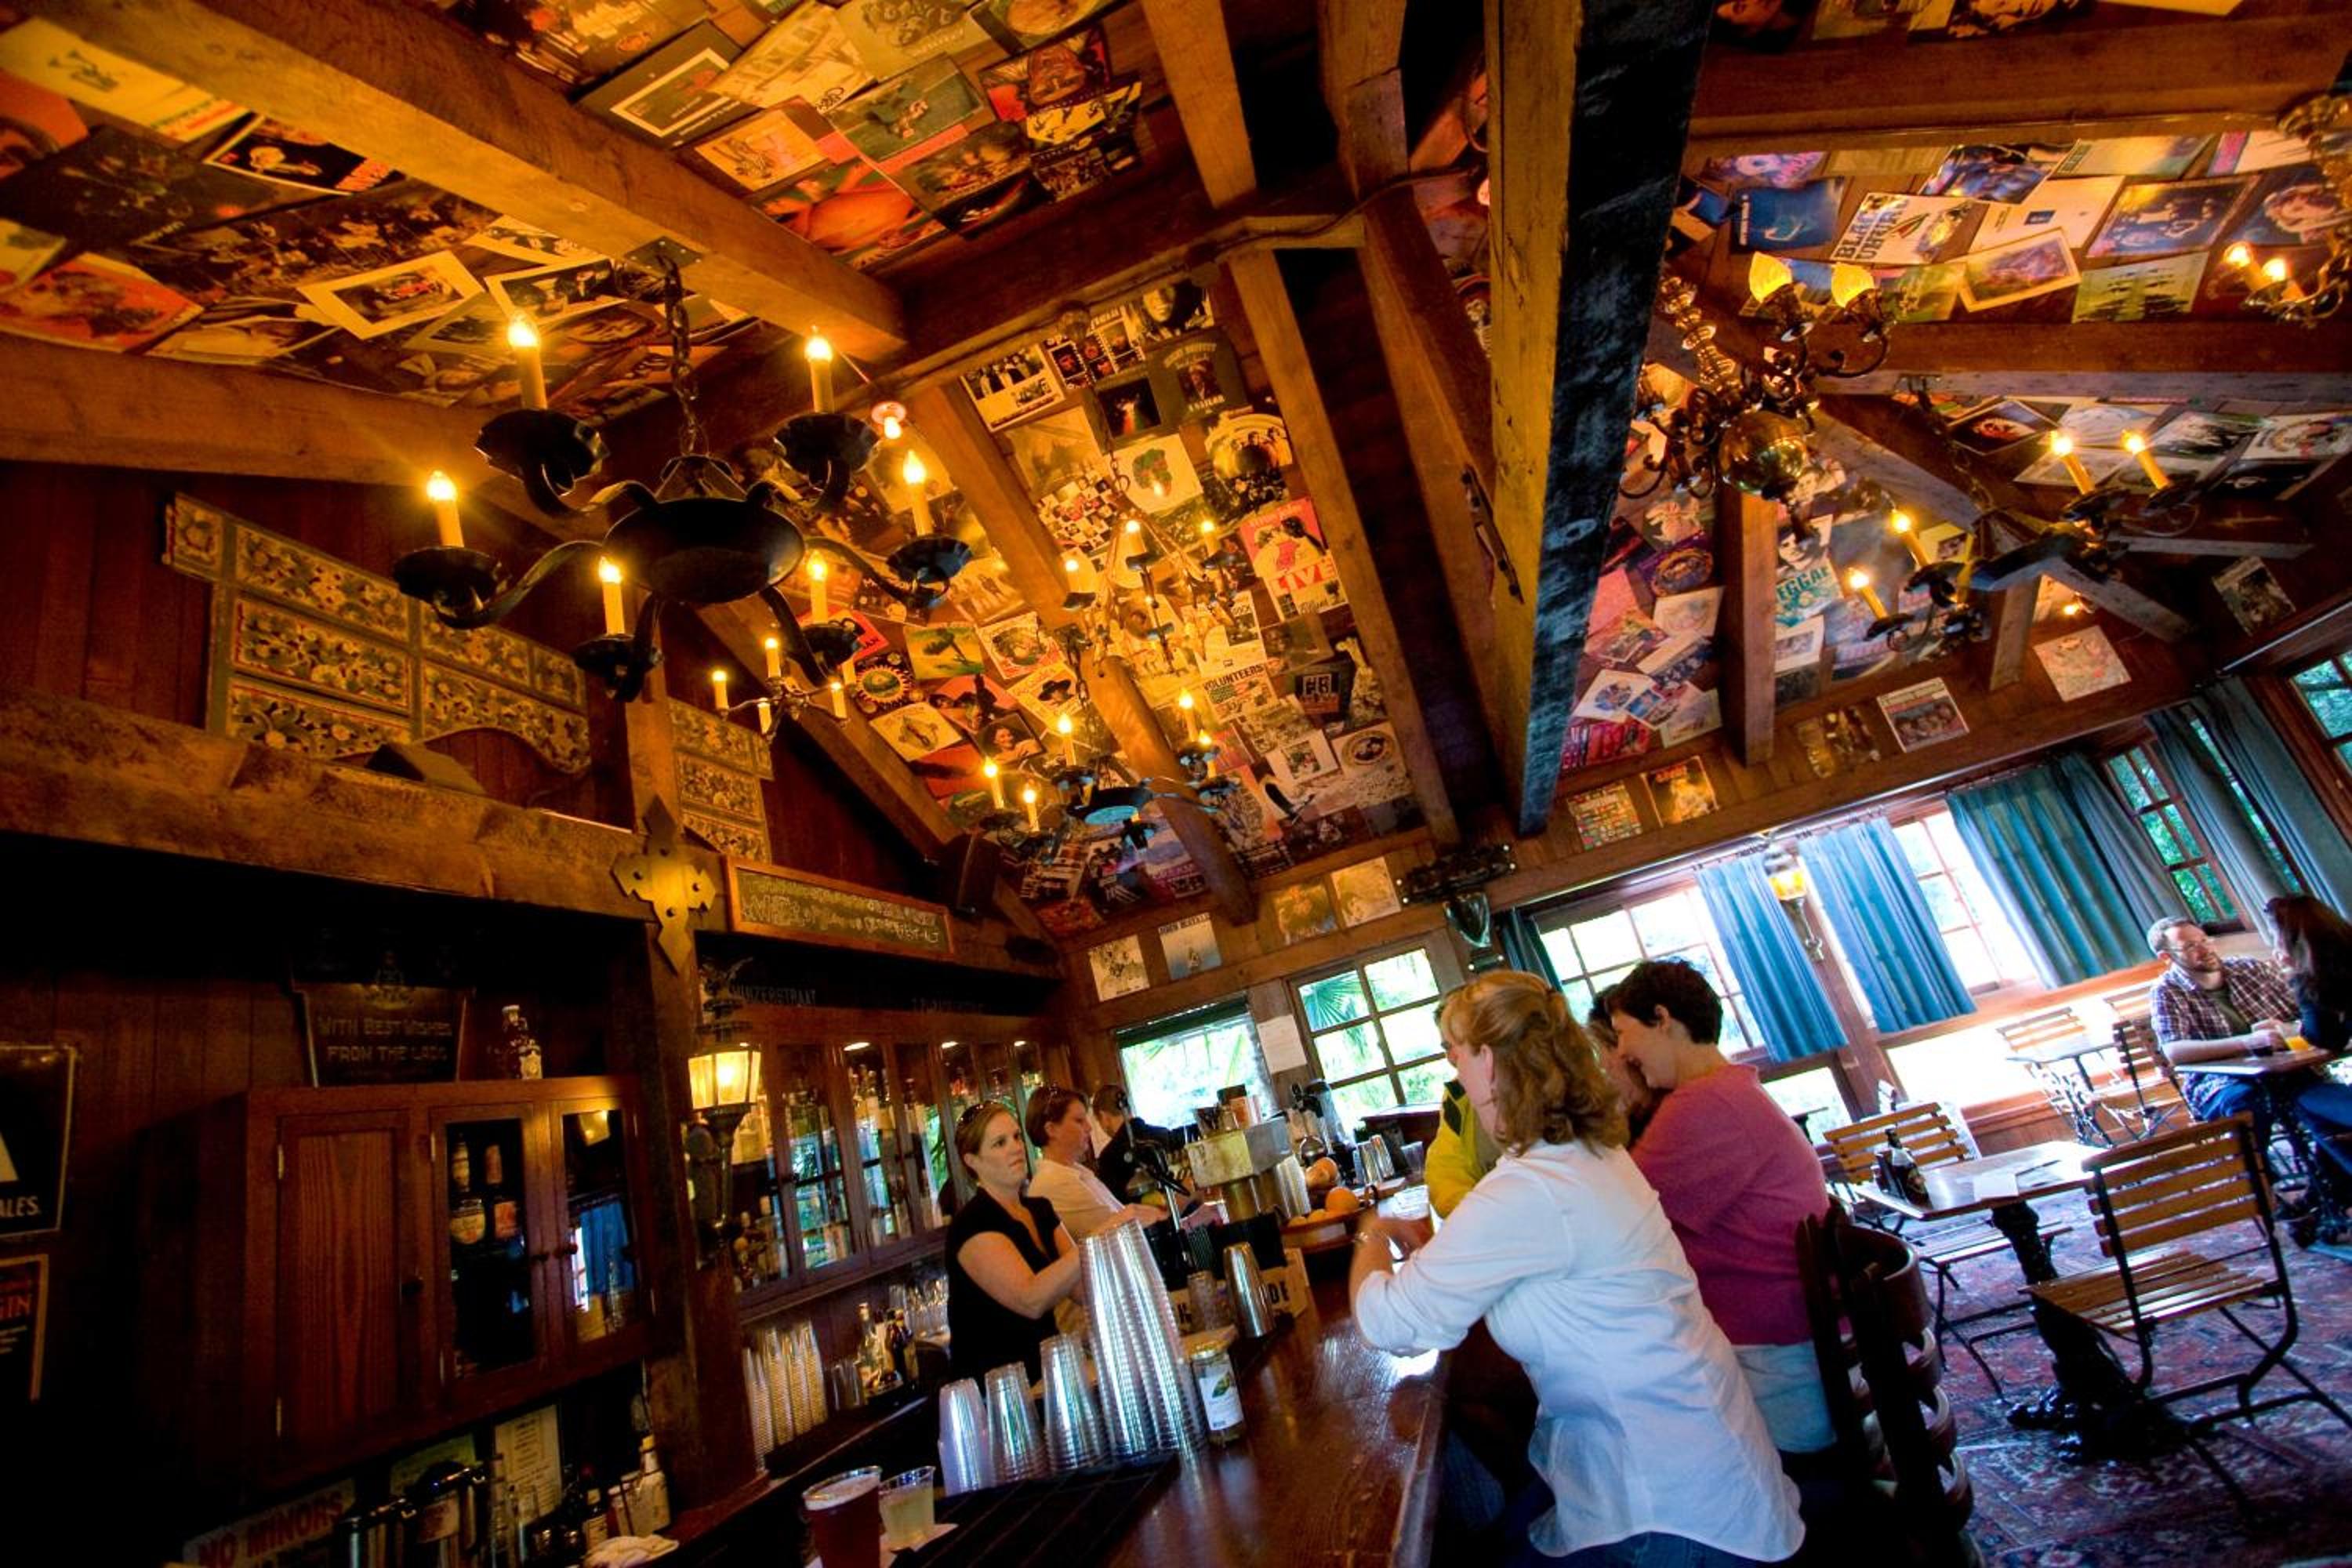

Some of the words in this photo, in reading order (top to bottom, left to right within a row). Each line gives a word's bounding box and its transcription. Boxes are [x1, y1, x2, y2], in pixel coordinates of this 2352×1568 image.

[1272, 560, 1335, 593] LIVE
[1775, 567, 1831, 601] EGGAE
[1203, 663, 1265, 691] VOLUNTEERS
[317, 1016, 358, 1037] WITH
[363, 1017, 402, 1036] BEST
[327, 1046, 373, 1063] FROM
[376, 1046, 408, 1062] THE
[248, 1491, 345, 1557] MINORS
